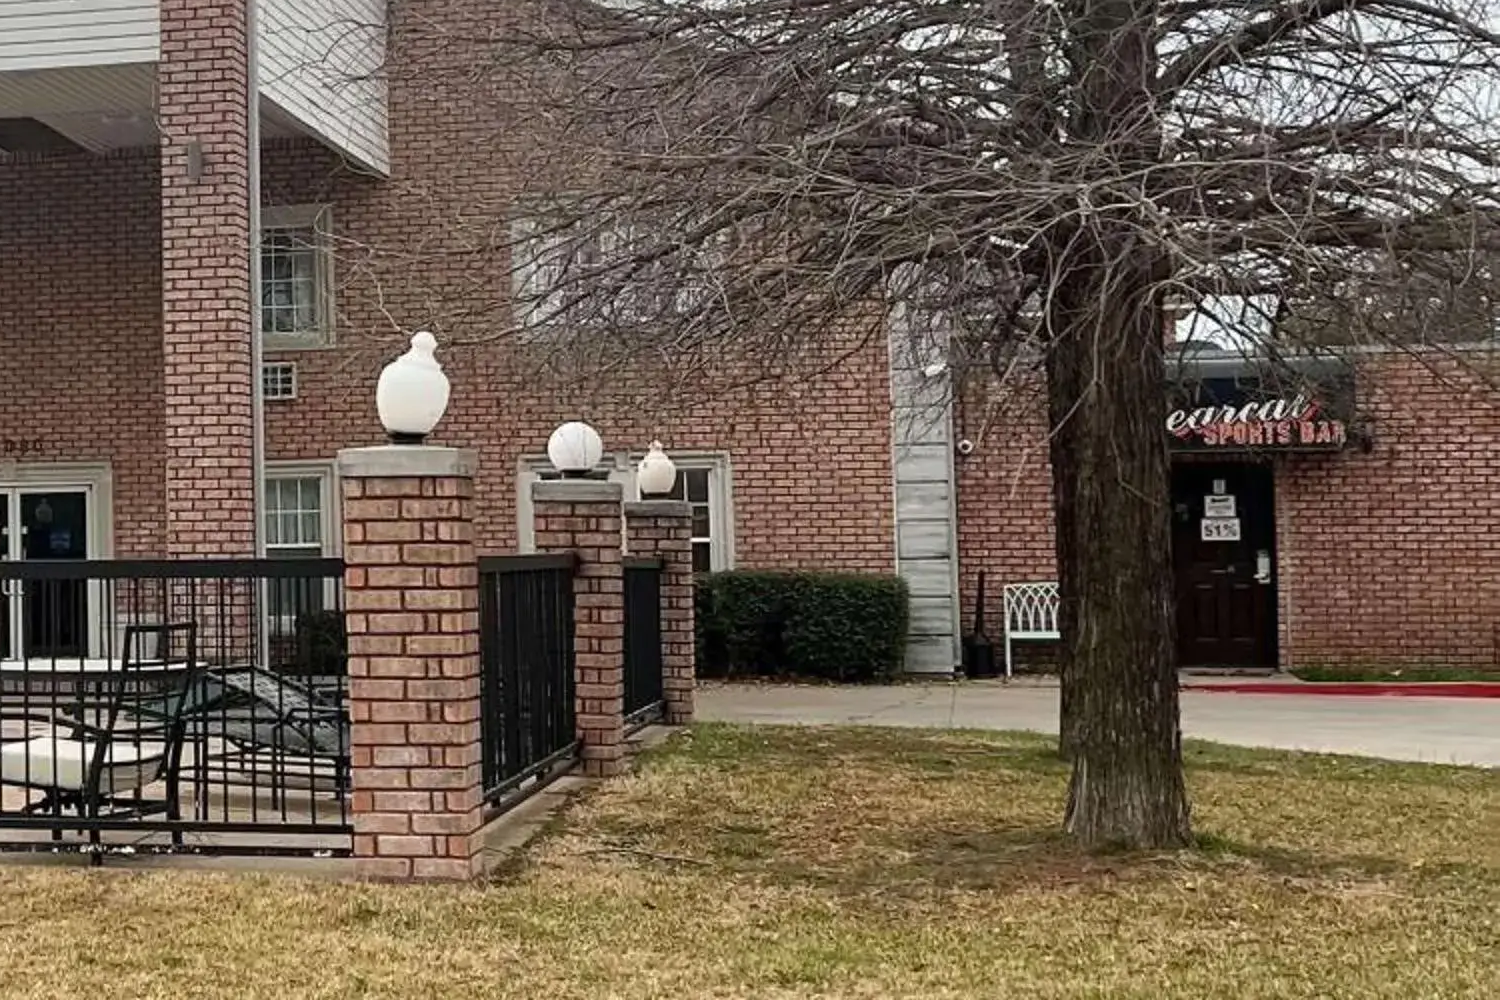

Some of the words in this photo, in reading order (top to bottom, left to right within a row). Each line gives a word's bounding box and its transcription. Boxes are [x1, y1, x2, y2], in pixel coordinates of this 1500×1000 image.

[1165, 391, 1311, 432] earcat
[1202, 420, 1291, 445] SPORTS
[1300, 419, 1347, 446] BAR
[1204, 524, 1237, 537] 51%
